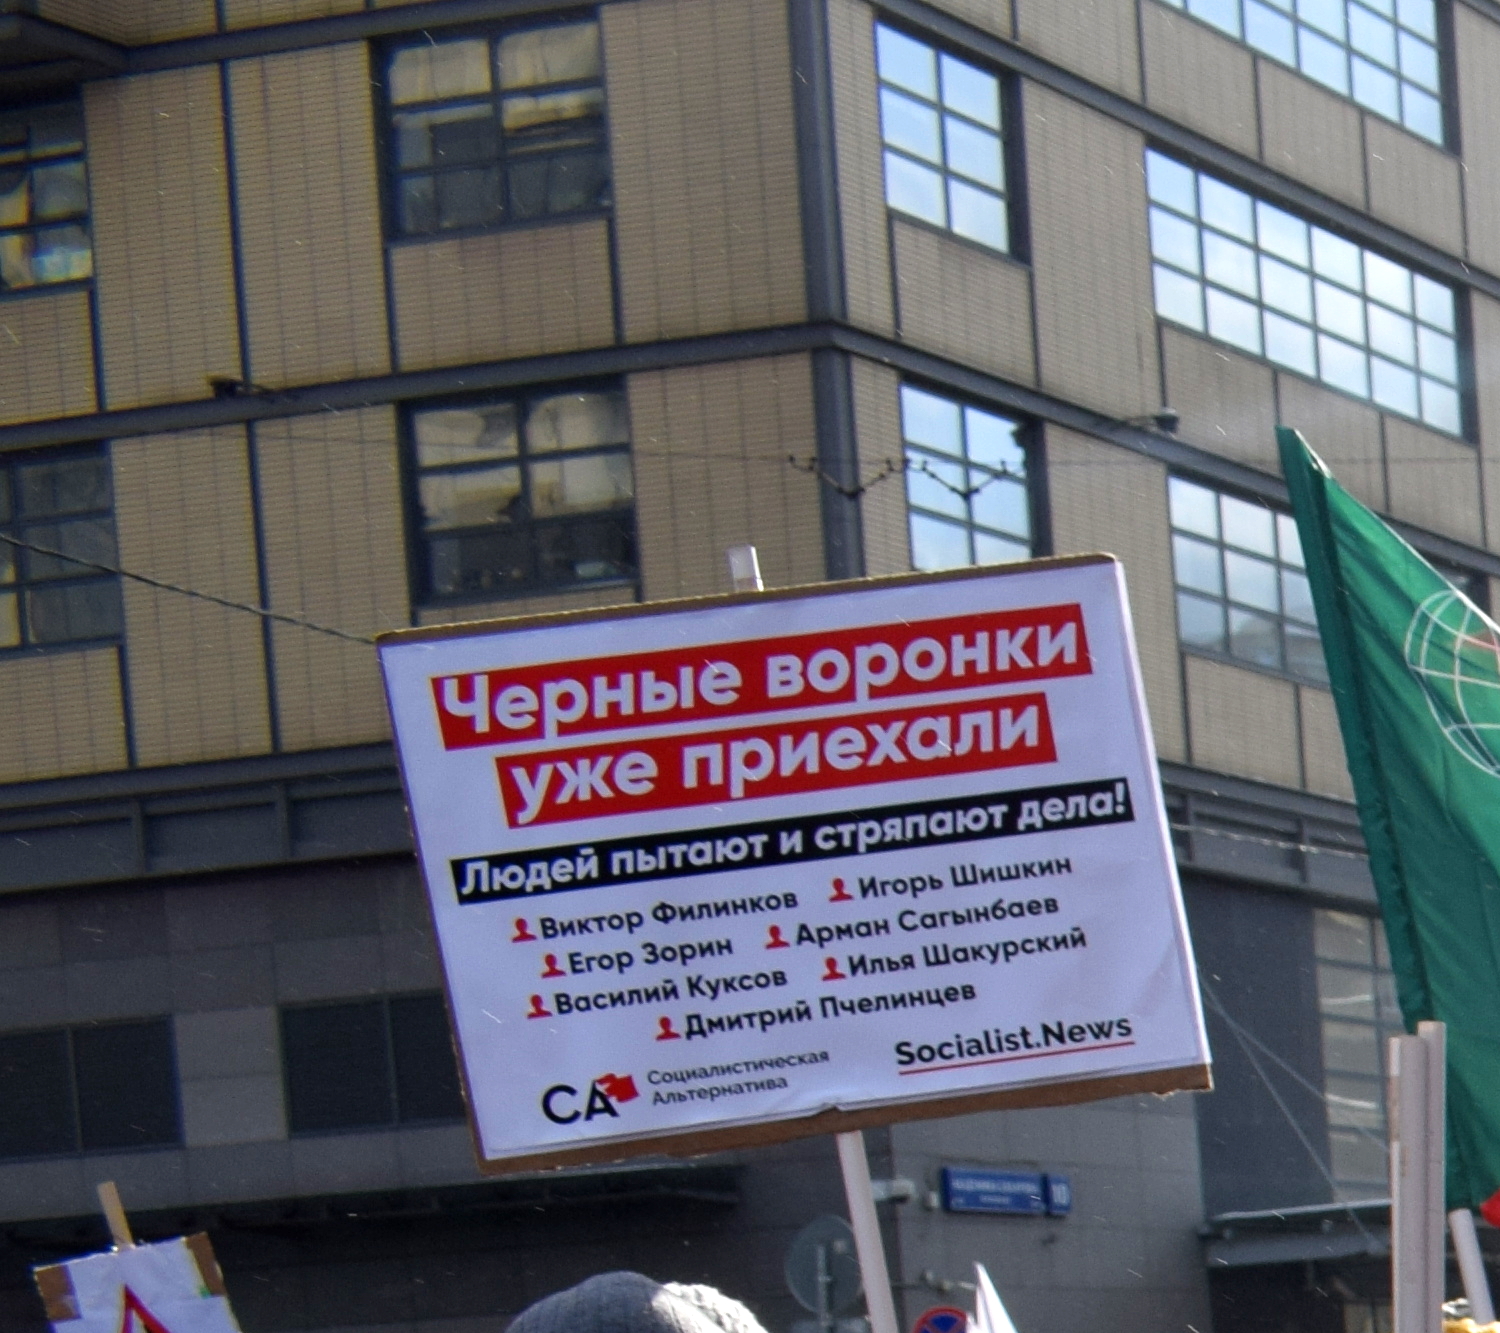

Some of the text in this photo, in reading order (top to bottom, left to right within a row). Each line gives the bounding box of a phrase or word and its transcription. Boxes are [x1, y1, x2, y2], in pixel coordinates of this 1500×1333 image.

[444, 624, 1077, 737] Черные воронки
[512, 705, 1038, 825] уже приехали
[462, 782, 1124, 895] Людей пытают и стряпают дела!
[857, 858, 1072, 899] Игорь Шишкин
[538, 892, 799, 940] Виктор Филинков
[796, 897, 1059, 949] Арман Сагынбаев
[567, 938, 733, 974] Егор Зорин
[847, 926, 1087, 977] Илья Шакурский
[553, 970, 788, 1015] Василий Куксов
[684, 984, 976, 1041] Дмитрий Пчелинцев
[894, 1018, 1133, 1062] Socialist.News
[646, 1050, 830, 1086] Социалистическая
[651, 1076, 789, 1106] Альтернатива
